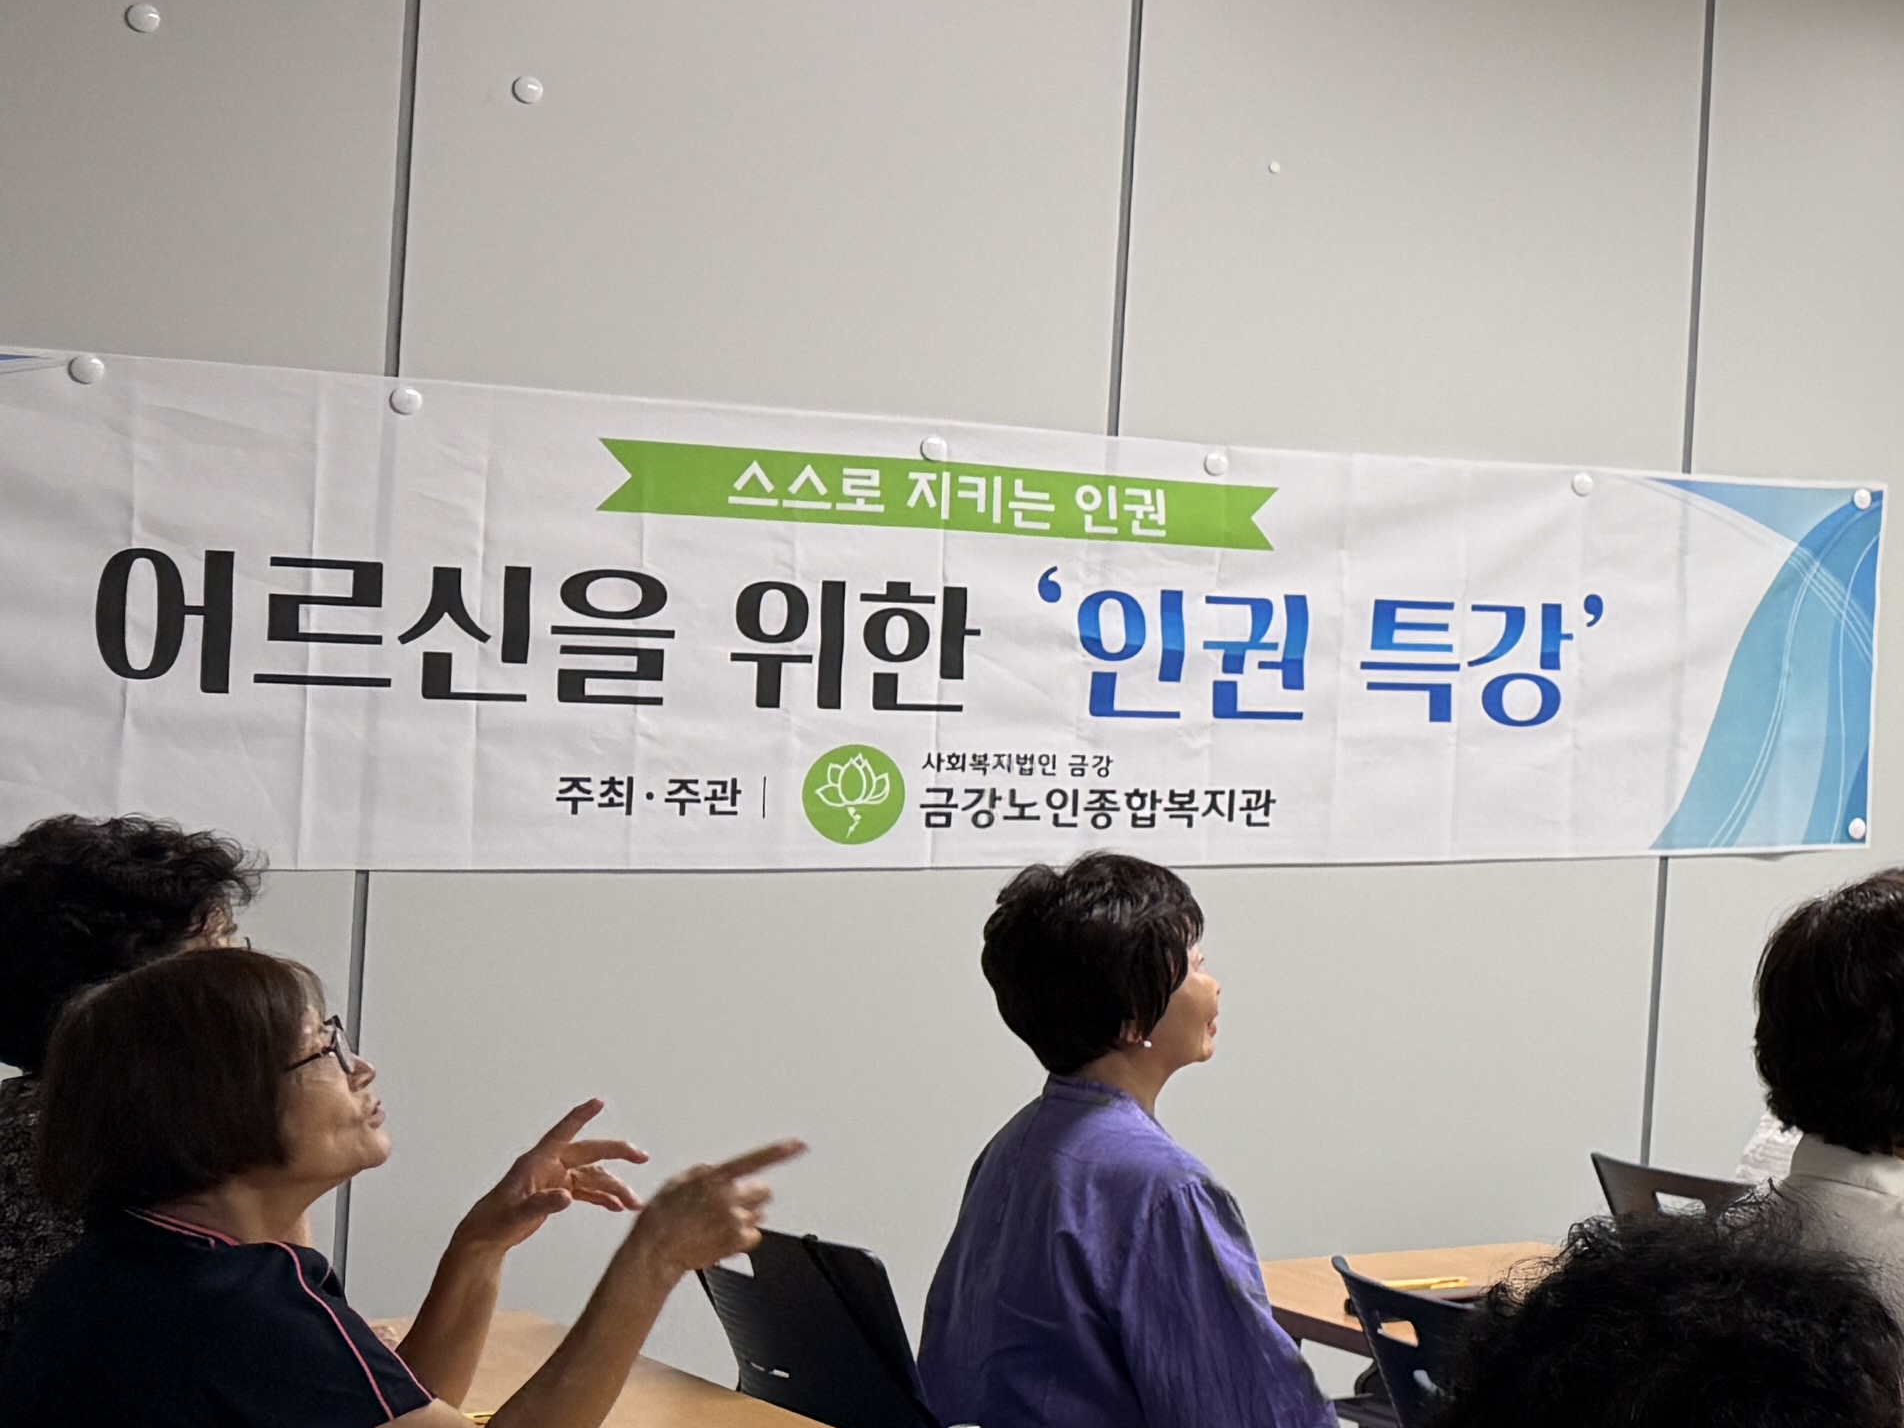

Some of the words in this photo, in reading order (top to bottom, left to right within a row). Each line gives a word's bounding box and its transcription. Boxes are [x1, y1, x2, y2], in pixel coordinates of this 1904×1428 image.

[727, 459, 885, 513] 스스로
[906, 471, 1056, 531] 지키는
[1074, 484, 1167, 538] 인권
[94, 547, 676, 707] 어르신을
[729, 579, 982, 712] 위한
[921, 752, 1059, 776] 사회복지법인
[1068, 753, 1115, 779] 금강
[918, 785, 1278, 831] 금강노인종합복지관
